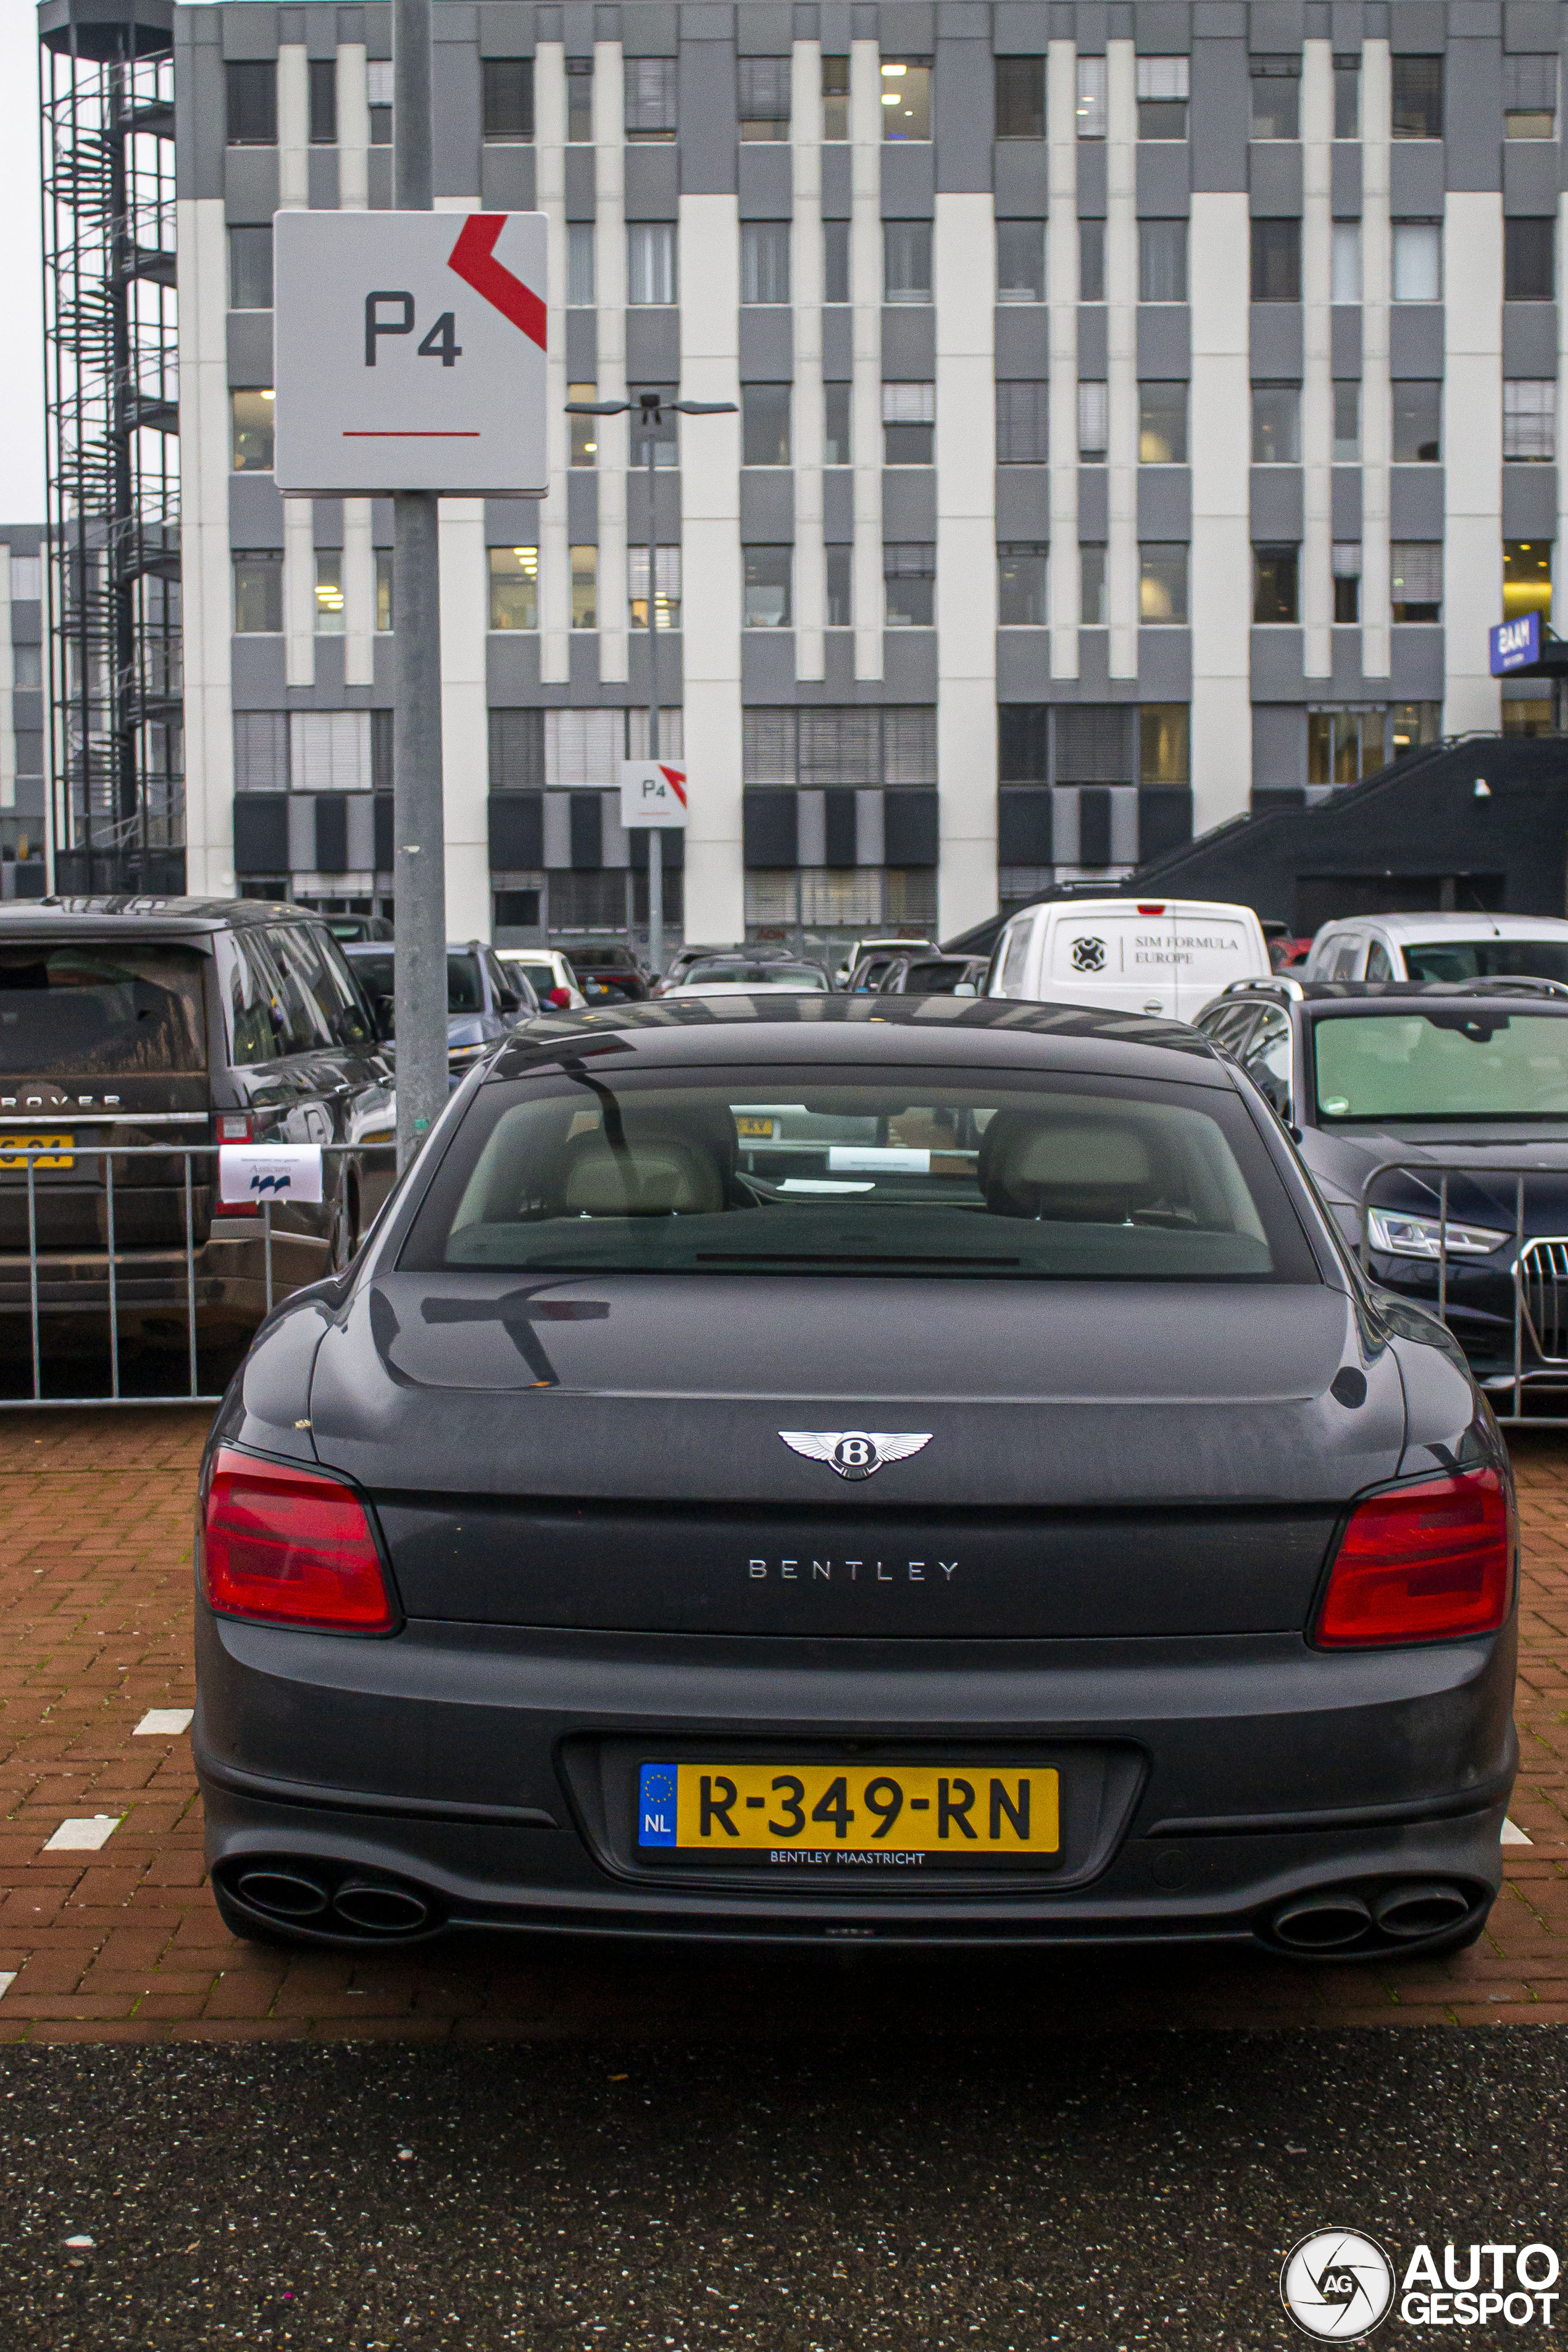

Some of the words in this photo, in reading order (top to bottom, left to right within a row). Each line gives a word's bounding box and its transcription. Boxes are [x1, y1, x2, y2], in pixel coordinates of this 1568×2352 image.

[364, 291, 462, 367] P4
[642, 779, 666, 798] P4
[1135, 936, 1161, 947] SIM
[1167, 936, 1239, 950] FORMULA
[1135, 953, 1193, 964] EUROPE
[1, 1095, 121, 1106] ROVER
[749, 1559, 958, 1581] BENTLEY
[645, 1814, 670, 1833] NL
[699, 1775, 1030, 1840] R-349-RN
[770, 1851, 831, 1864] BENTLEY
[836, 1851, 925, 1865] MAASTRICHT
